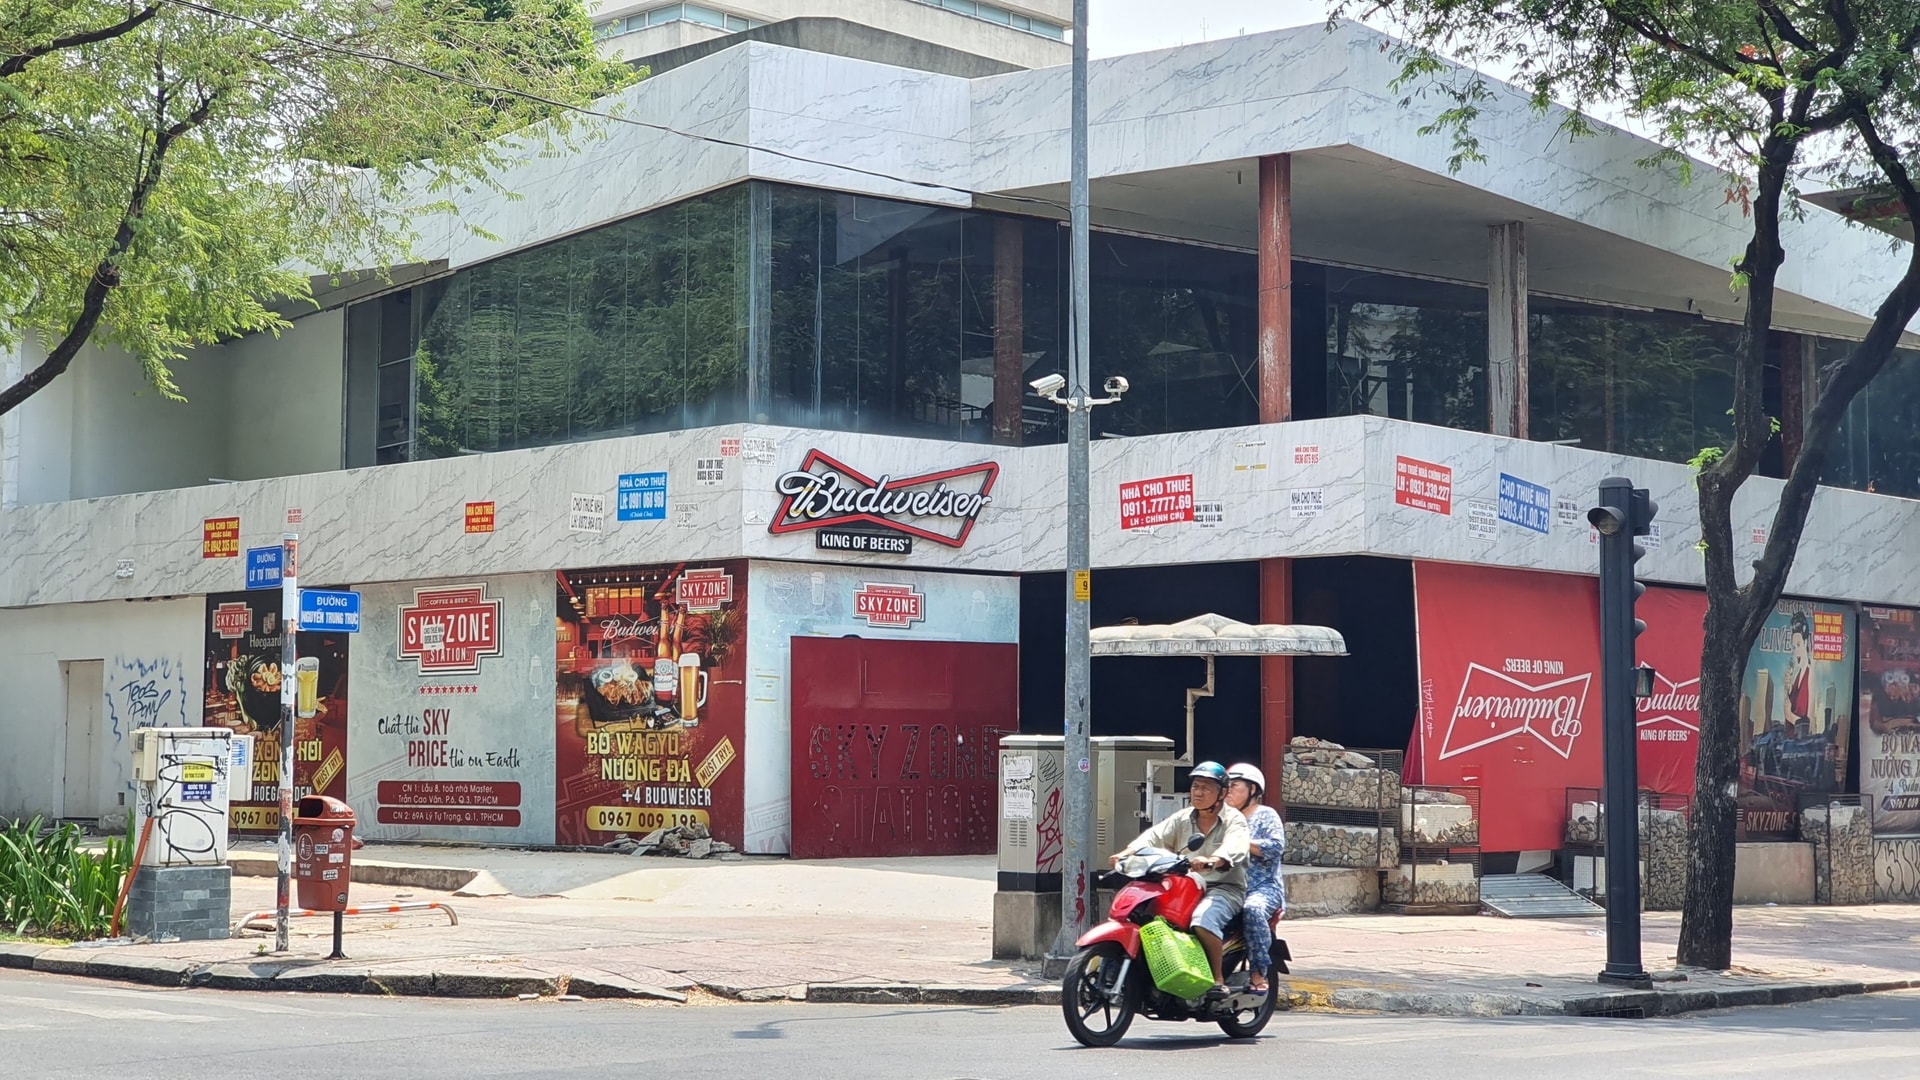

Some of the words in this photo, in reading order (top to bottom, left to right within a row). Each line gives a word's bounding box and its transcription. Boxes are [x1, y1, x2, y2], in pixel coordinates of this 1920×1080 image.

[621, 475, 634, 488] NHÀ
[634, 478, 649, 487] CHO
[651, 474, 666, 486] THUÊ
[1121, 484, 1141, 501] NHÀ
[1143, 481, 1164, 498] CHO
[1165, 475, 1192, 494] THUÊ
[1397, 475, 1406, 491] LH
[776, 470, 993, 520] Budweiser
[1301, 491, 1310, 504] CHO
[1500, 477, 1515, 498] CHO
[1517, 484, 1534, 505] THUÊ
[1536, 490, 1549, 510] NHÀ
[572, 496, 583, 512] CHO
[1122, 494, 1192, 518] 0911.7777.69
[1130, 517, 1139, 527] LH
[1145, 512, 1169, 524] CHÍNH
[1499, 497, 1549, 532] 0903.41.00.73
[821, 533, 850, 549] KING
[852, 535, 868, 549] OF
[256, 552, 276, 564] ĐƯỜNG
[249, 567, 257, 582] LÝ
[682, 582, 700, 597] SKY
[702, 581, 726, 596] ZONE
[316, 595, 348, 607] ĐƯỜNG
[860, 596, 884, 612] SKY
[886, 597, 917, 614] ZONE
[230, 612, 248, 626] ZONE
[301, 608, 325, 625] NGUYỄN
[325, 612, 344, 625] TRUNG
[875, 612, 901, 622] STATION
[446, 611, 491, 643] ZONE
[249, 632, 282, 650] Hoegaard
[1760, 626, 1792, 654] LIVE
[430, 647, 466, 663] STATION
[1531, 659, 1543, 674] OF
[1543, 660, 1564, 675] KING
[378, 714, 403, 735] Chất
[404, 715, 420, 736] thì
[423, 708, 450, 736] SKY
[1456, 695, 1582, 737] Budweiser
[587, 728, 610, 756] BÒ
[616, 731, 680, 756] WAGYU
[1640, 729, 1657, 741] KING
[1657, 730, 1666, 741] OF
[298, 738, 322, 762] HƠI
[408, 740, 448, 767] PRICE
[468, 755, 483, 768] on
[486, 748, 521, 769] Earth
[809, 724, 889, 779] SKY
[901, 724, 1000, 779] ZONE
[601, 754, 661, 783] NƯỚNG
[666, 755, 692, 783] ĐÁ
[699, 761, 718, 784] MUST
[401, 784, 413, 793] CN
[455, 783, 468, 793] nhà
[469, 784, 494, 795] Master,
[622, 787, 641, 804] +4
[645, 787, 712, 807] BUDWEISER
[413, 795, 427, 804] Cao
[234, 811, 261, 823] 0967
[265, 811, 280, 823] 00
[392, 811, 404, 820] CN
[411, 812, 424, 820] 69A
[425, 811, 433, 822] Lý
[480, 813, 504, 823] TPHCM
[599, 811, 632, 828] 0967
[638, 812, 664, 829] 009
[671, 813, 697, 830] 198
[1746, 811, 1790, 832] SKYZONE
